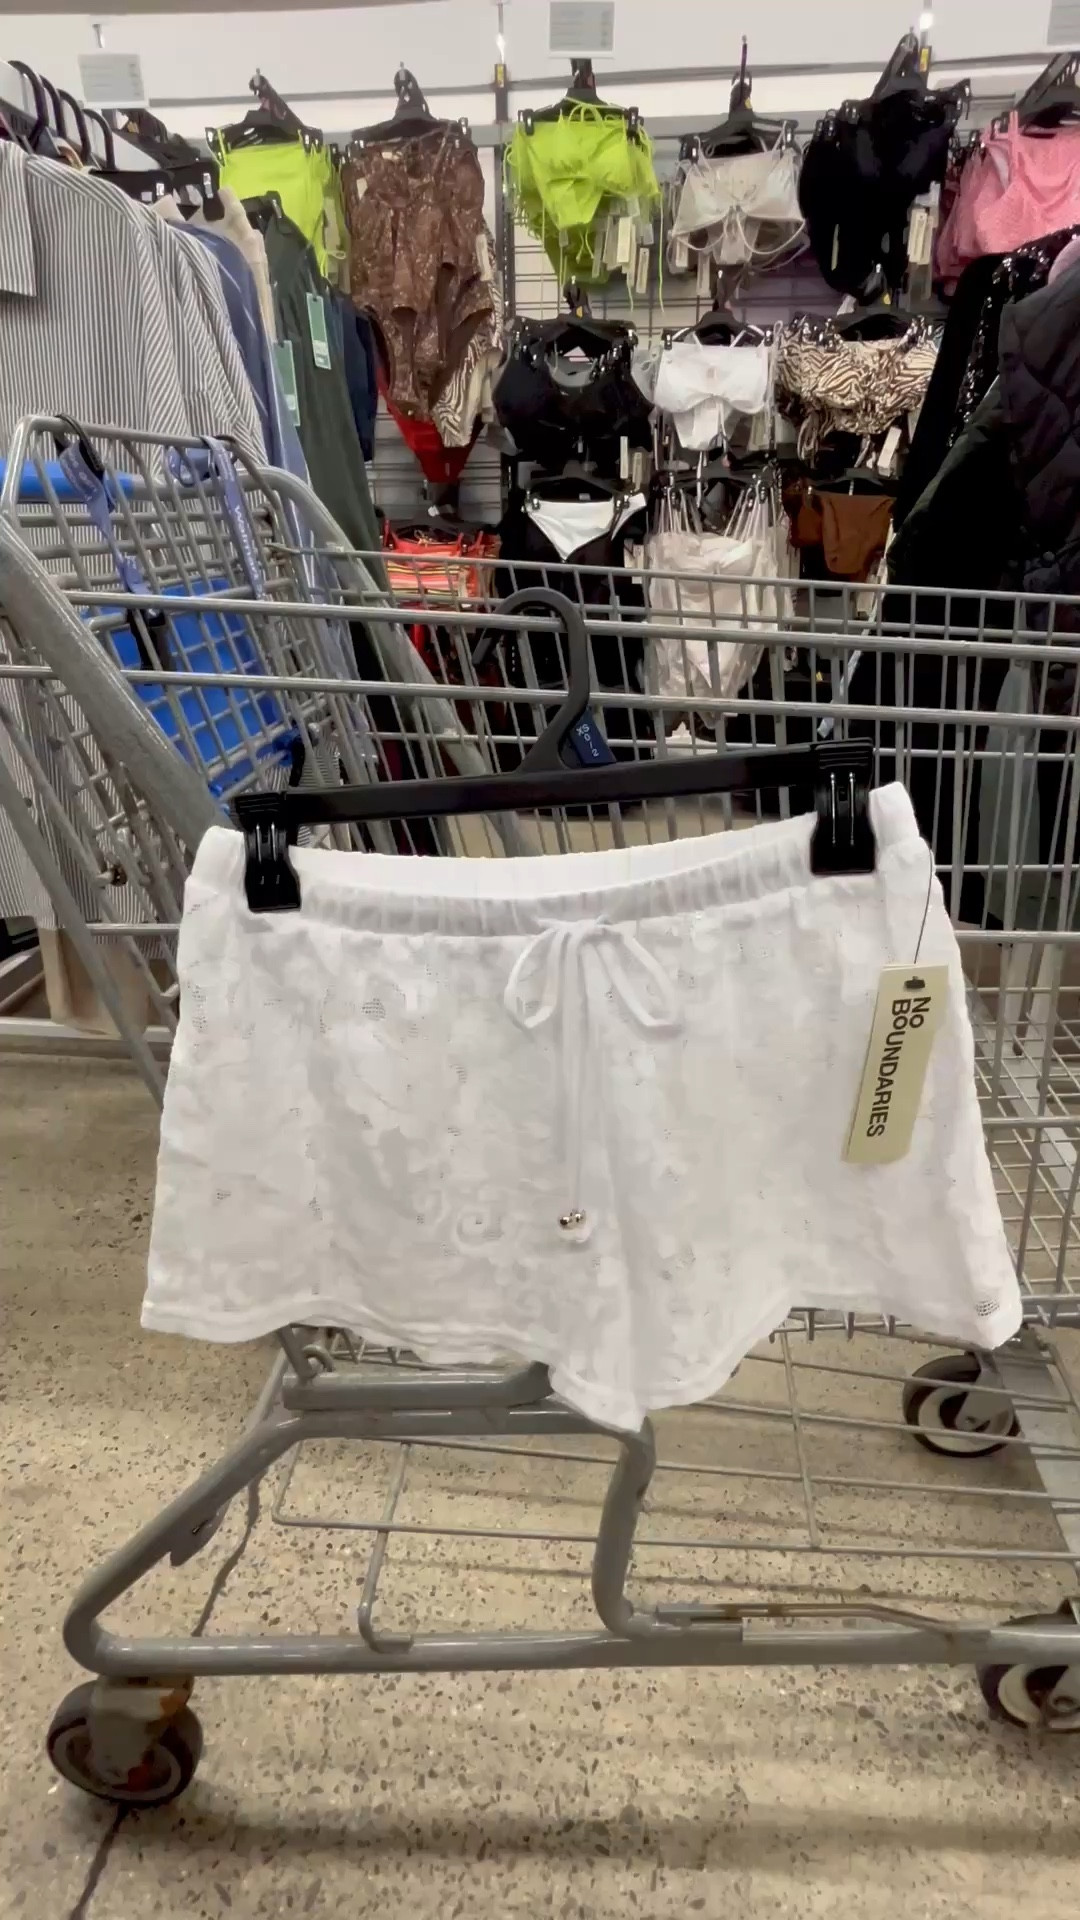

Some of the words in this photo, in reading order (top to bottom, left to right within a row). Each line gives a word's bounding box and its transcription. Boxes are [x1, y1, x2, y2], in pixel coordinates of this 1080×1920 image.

[576, 723, 590, 736] XS
[909, 996, 931, 1028] NO
[866, 998, 911, 1138] BOUNDARIES
